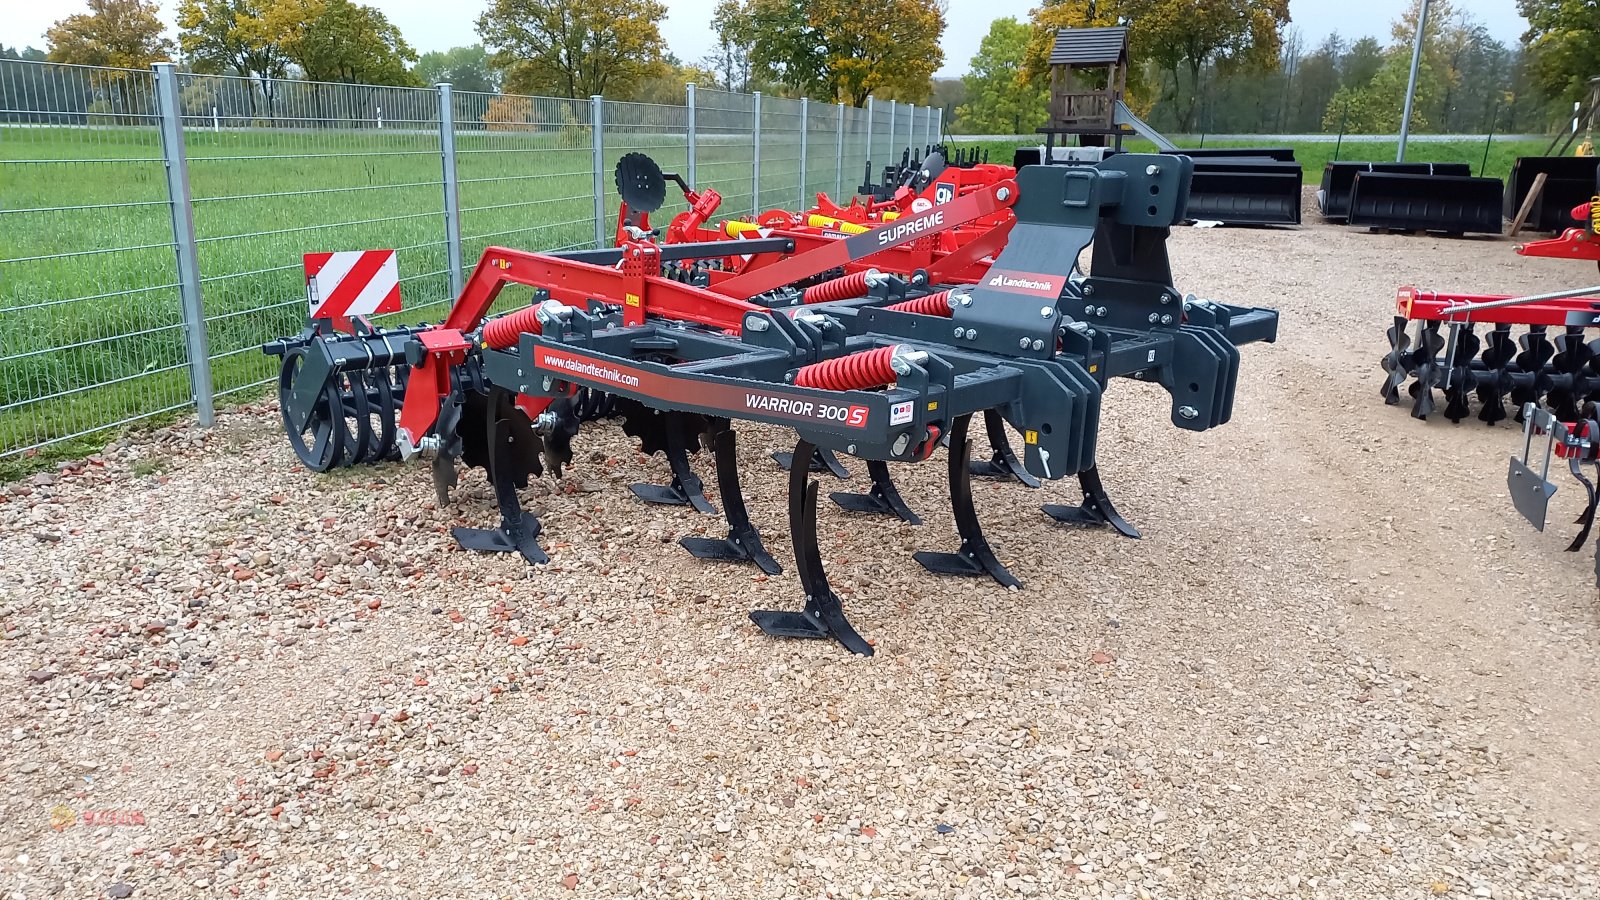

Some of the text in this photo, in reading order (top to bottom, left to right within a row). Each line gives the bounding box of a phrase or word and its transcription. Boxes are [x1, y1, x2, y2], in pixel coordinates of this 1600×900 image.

[878, 210, 943, 245] SUPREME
[1003, 277, 1052, 291] Landtechnik
[544, 354, 639, 387] www.dalandtechnik.com
[746, 393, 814, 417] WARRIOR
